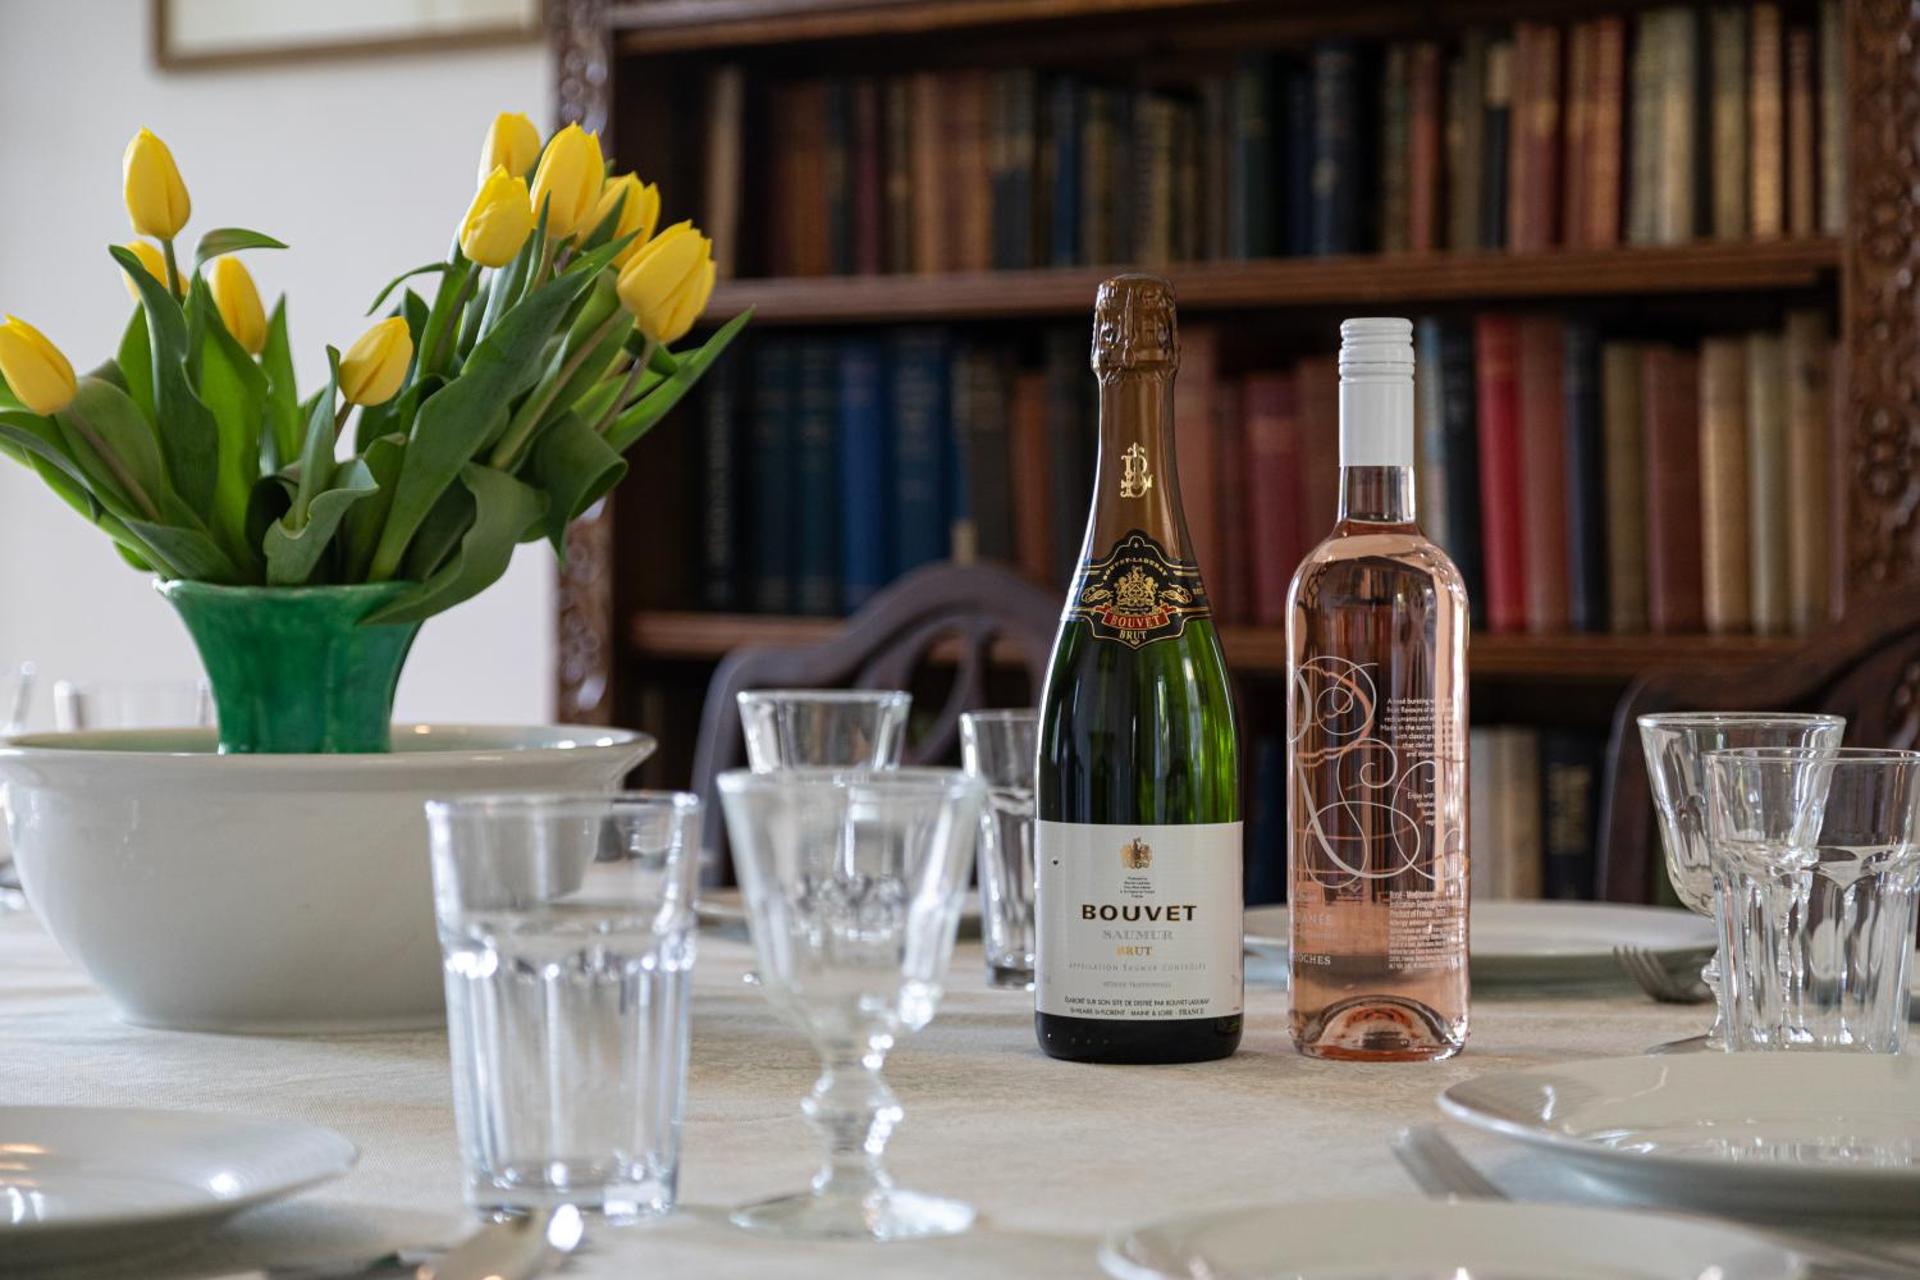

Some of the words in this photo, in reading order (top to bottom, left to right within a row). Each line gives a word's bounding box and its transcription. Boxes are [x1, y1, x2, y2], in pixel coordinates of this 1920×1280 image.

[1110, 614, 1161, 628] BOUVET
[1119, 630, 1147, 640] BRUT
[1082, 903, 1197, 921] BOUVET
[1102, 929, 1174, 941] SAUMUR
[1116, 946, 1153, 956] BRUT
[1296, 951, 1332, 966] OCHES
